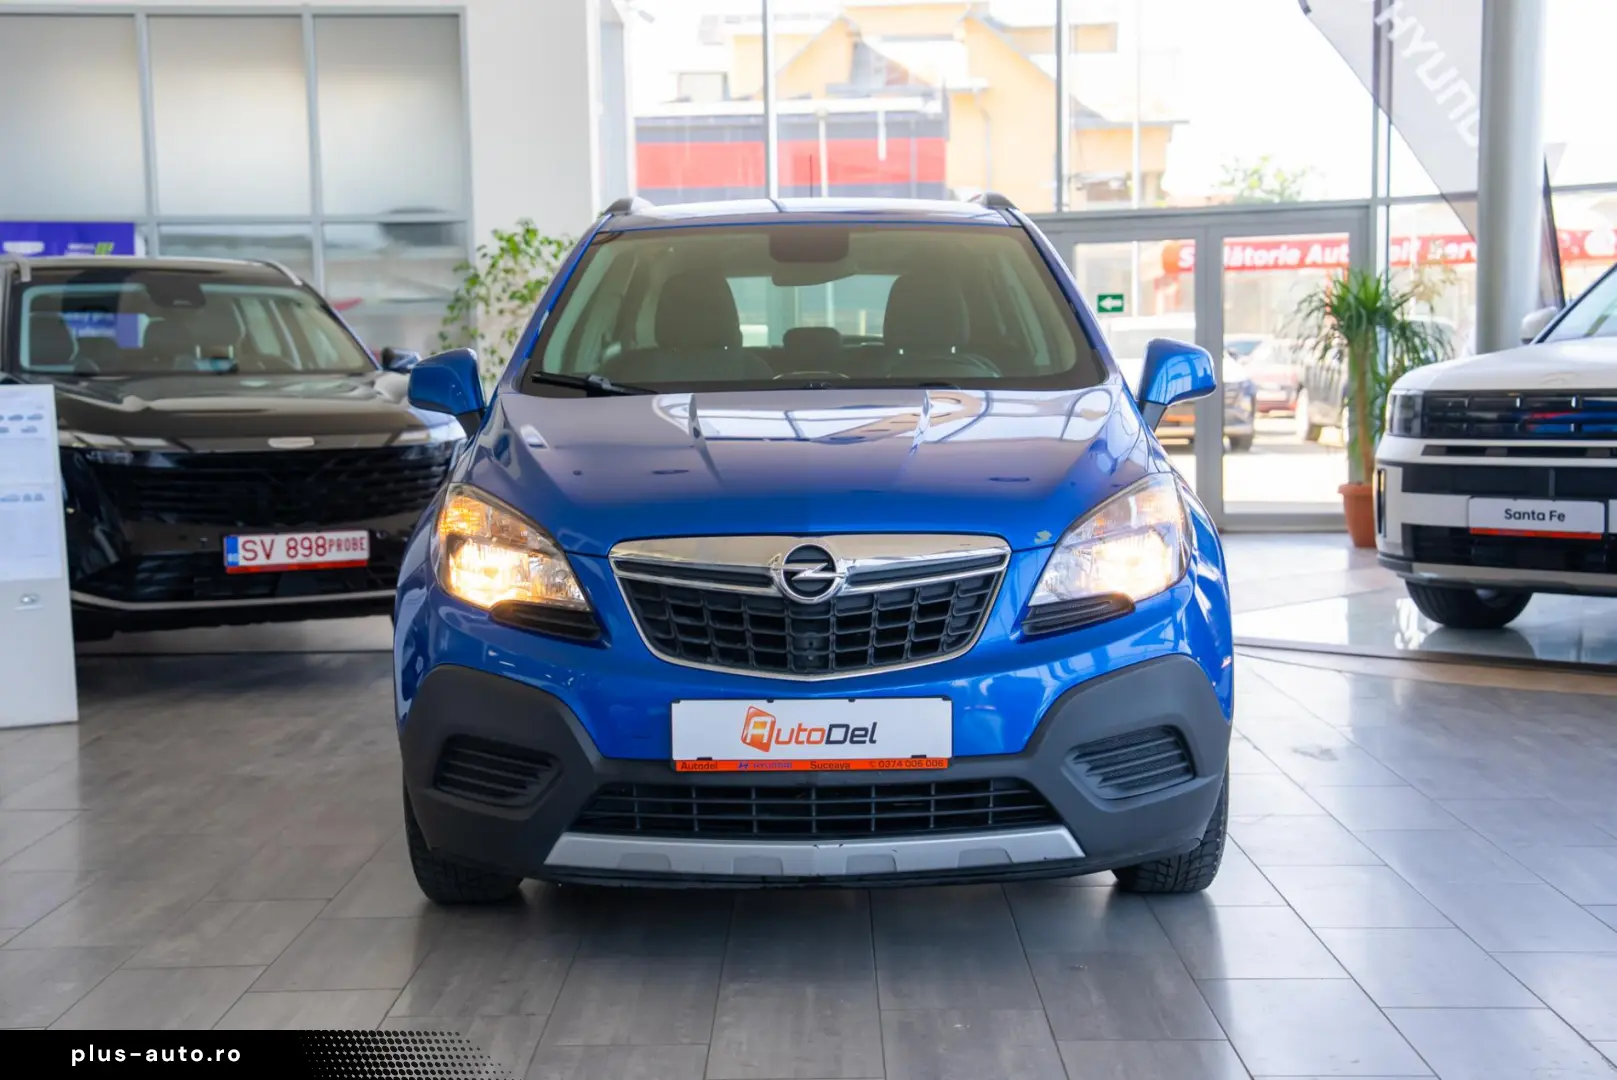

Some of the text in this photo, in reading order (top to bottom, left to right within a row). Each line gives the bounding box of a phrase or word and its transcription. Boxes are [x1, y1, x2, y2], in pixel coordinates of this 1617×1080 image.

[1177, 244, 1301, 268] Slătorie
[1304, 243, 1350, 265] Aut
[1504, 508, 1566, 522] Santa Fe
[241, 538, 275, 562] SV
[285, 536, 328, 559] 898
[328, 536, 367, 553] PROBE
[743, 709, 878, 750] AutoDel
[680, 761, 719, 771] Autodel
[810, 760, 851, 770] Suceava
[878, 759, 903, 769] 0374
